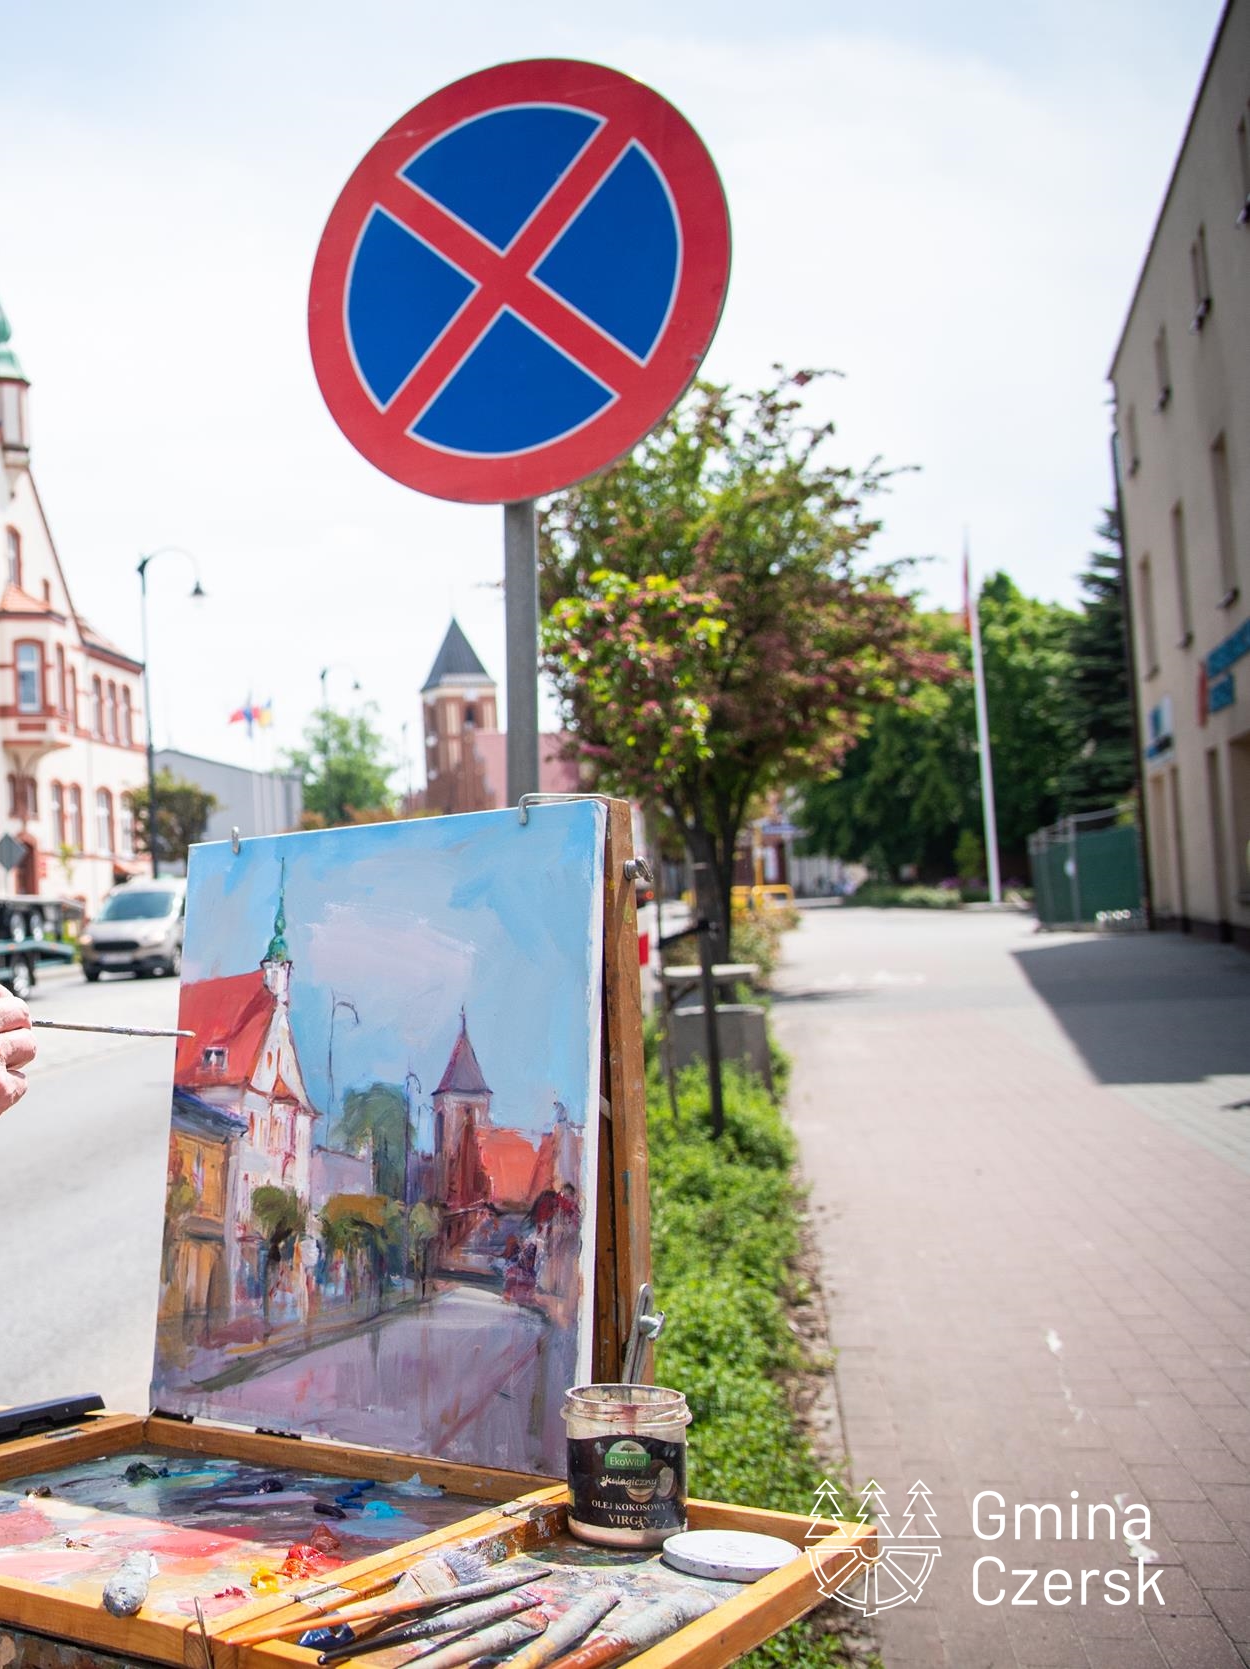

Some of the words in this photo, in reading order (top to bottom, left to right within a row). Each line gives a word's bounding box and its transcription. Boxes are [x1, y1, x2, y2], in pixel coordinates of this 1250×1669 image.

[609, 1456, 647, 1467] EkoWital
[591, 1499, 613, 1510] OLEJ
[615, 1503, 666, 1512] KOKOSOWY
[608, 1514, 650, 1526] VIRGIN
